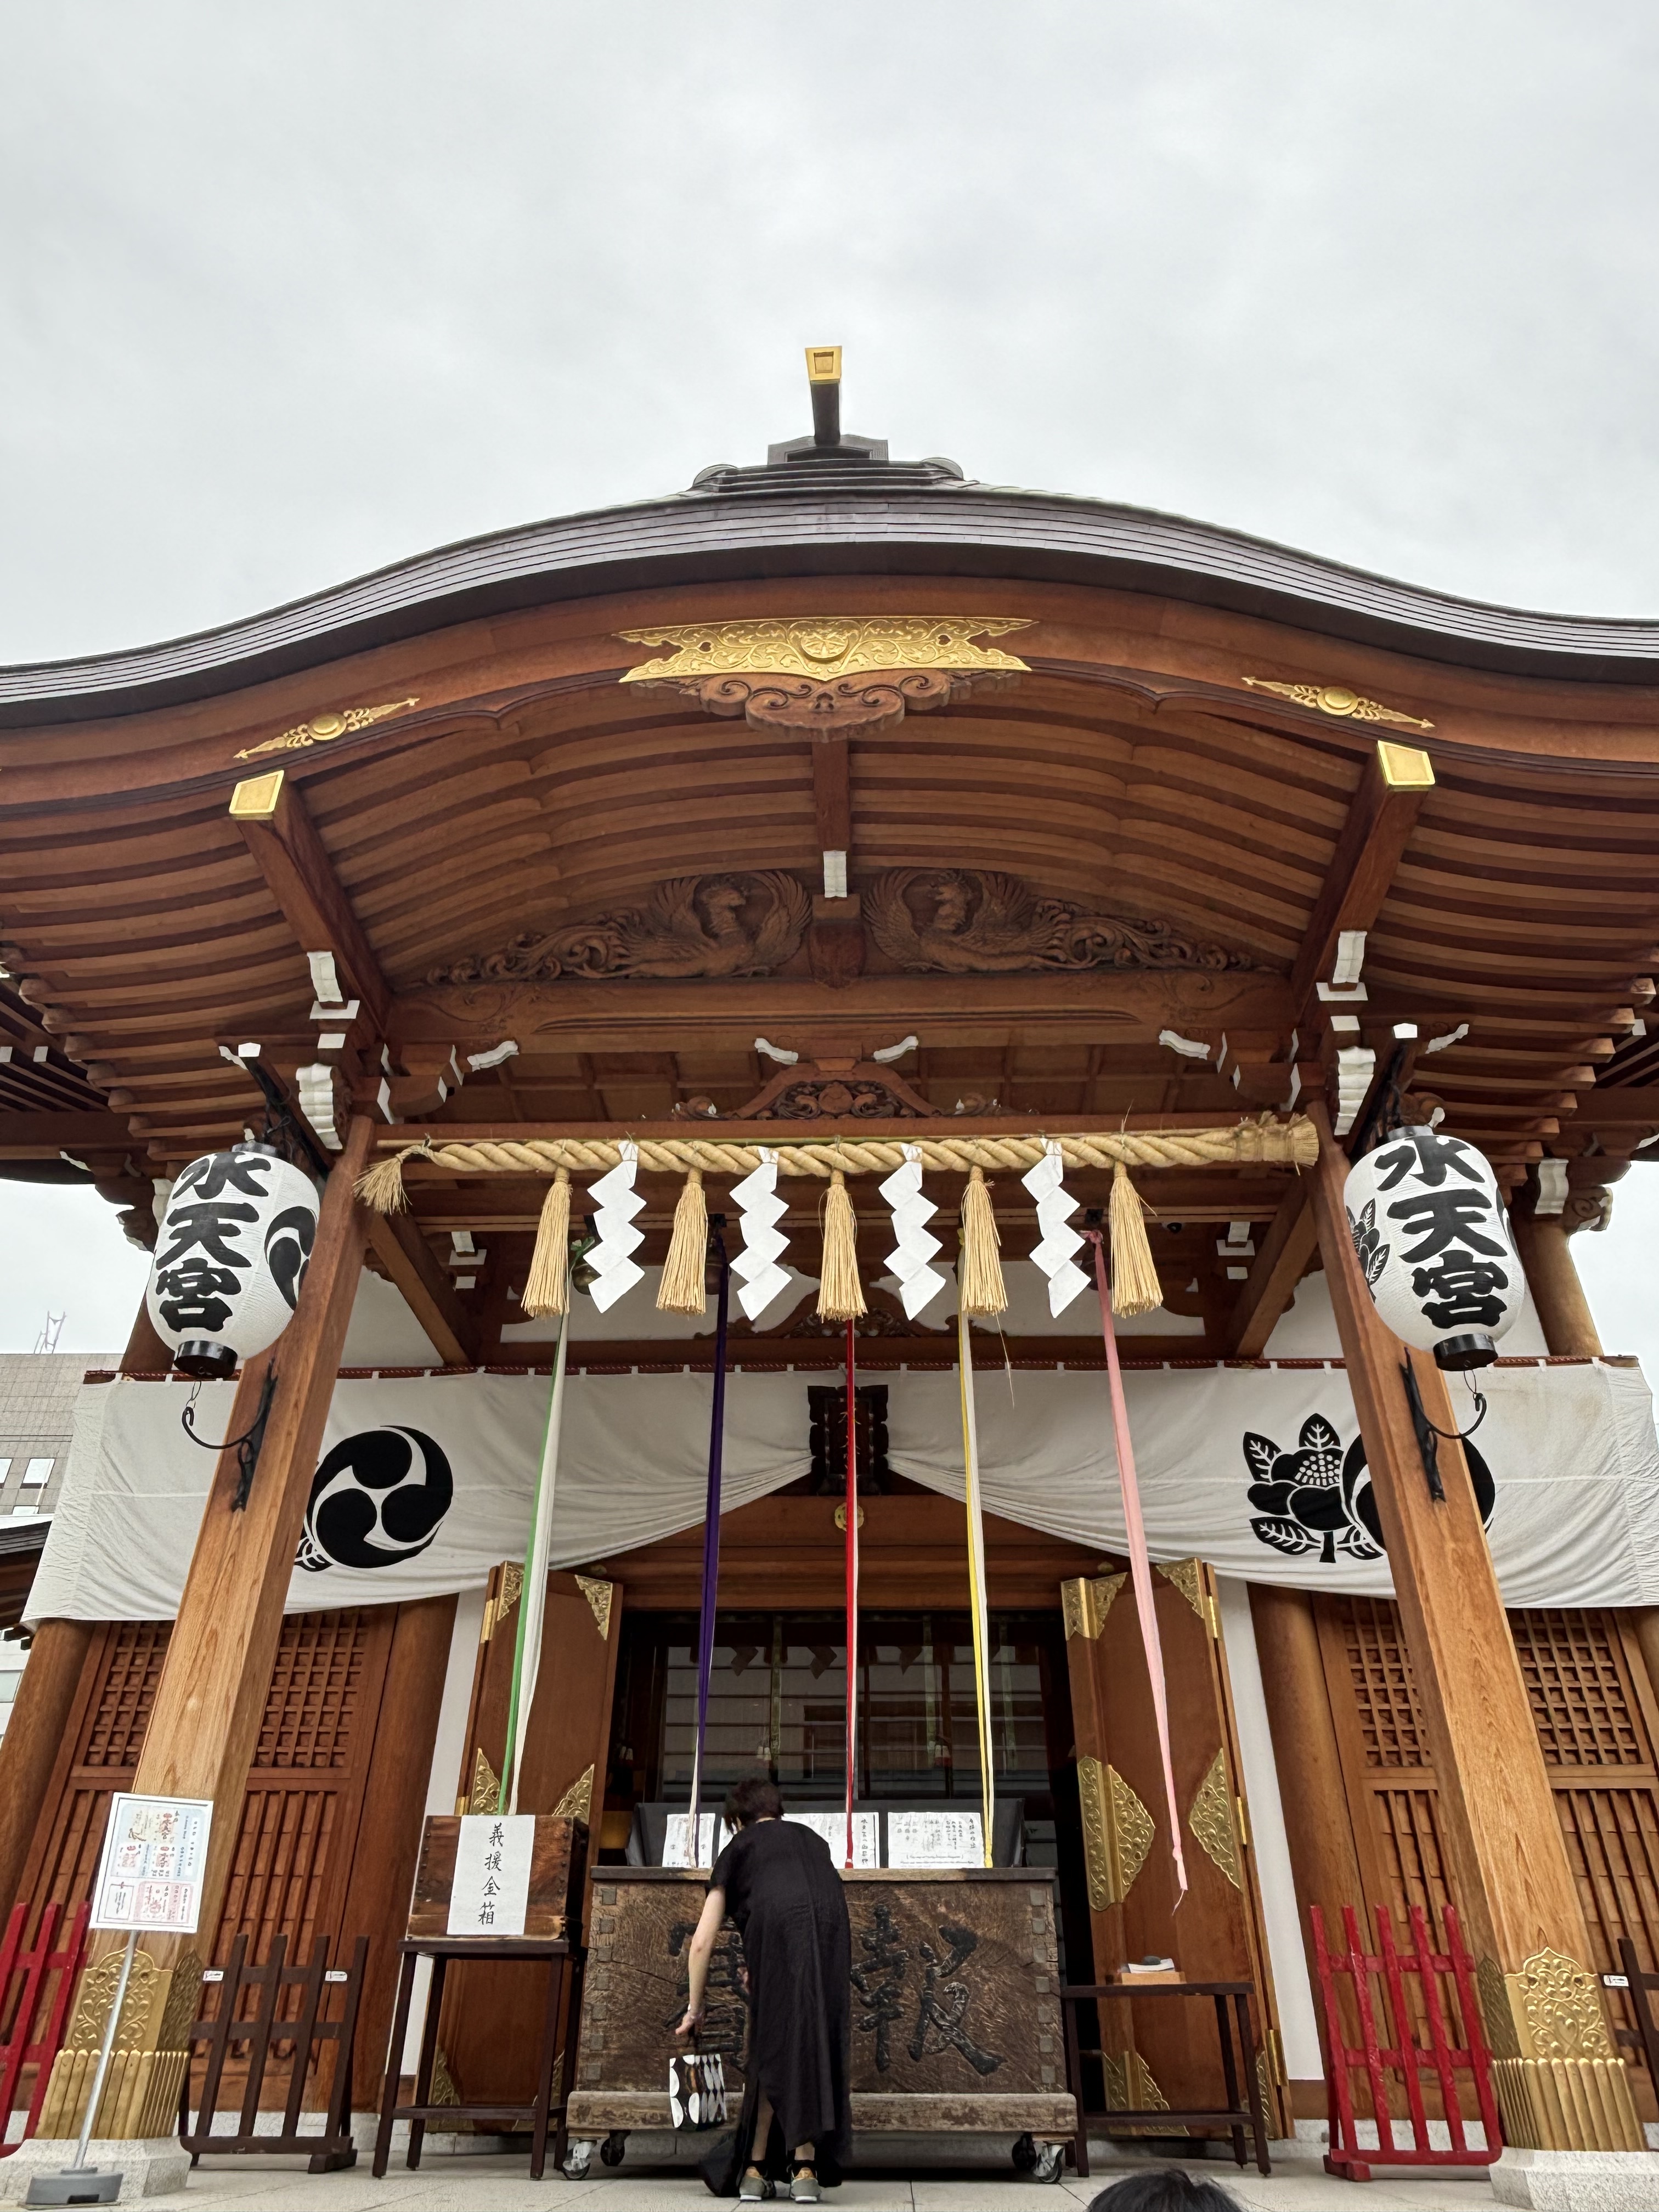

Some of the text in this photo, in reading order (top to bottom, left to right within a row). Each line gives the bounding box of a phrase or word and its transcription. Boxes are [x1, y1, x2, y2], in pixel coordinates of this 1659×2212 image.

[156, 1152, 272, 1332] 水天宮
[1374, 1136, 1509, 1329] 水天宮
[478, 1822, 505, 1926] 義援金箱
